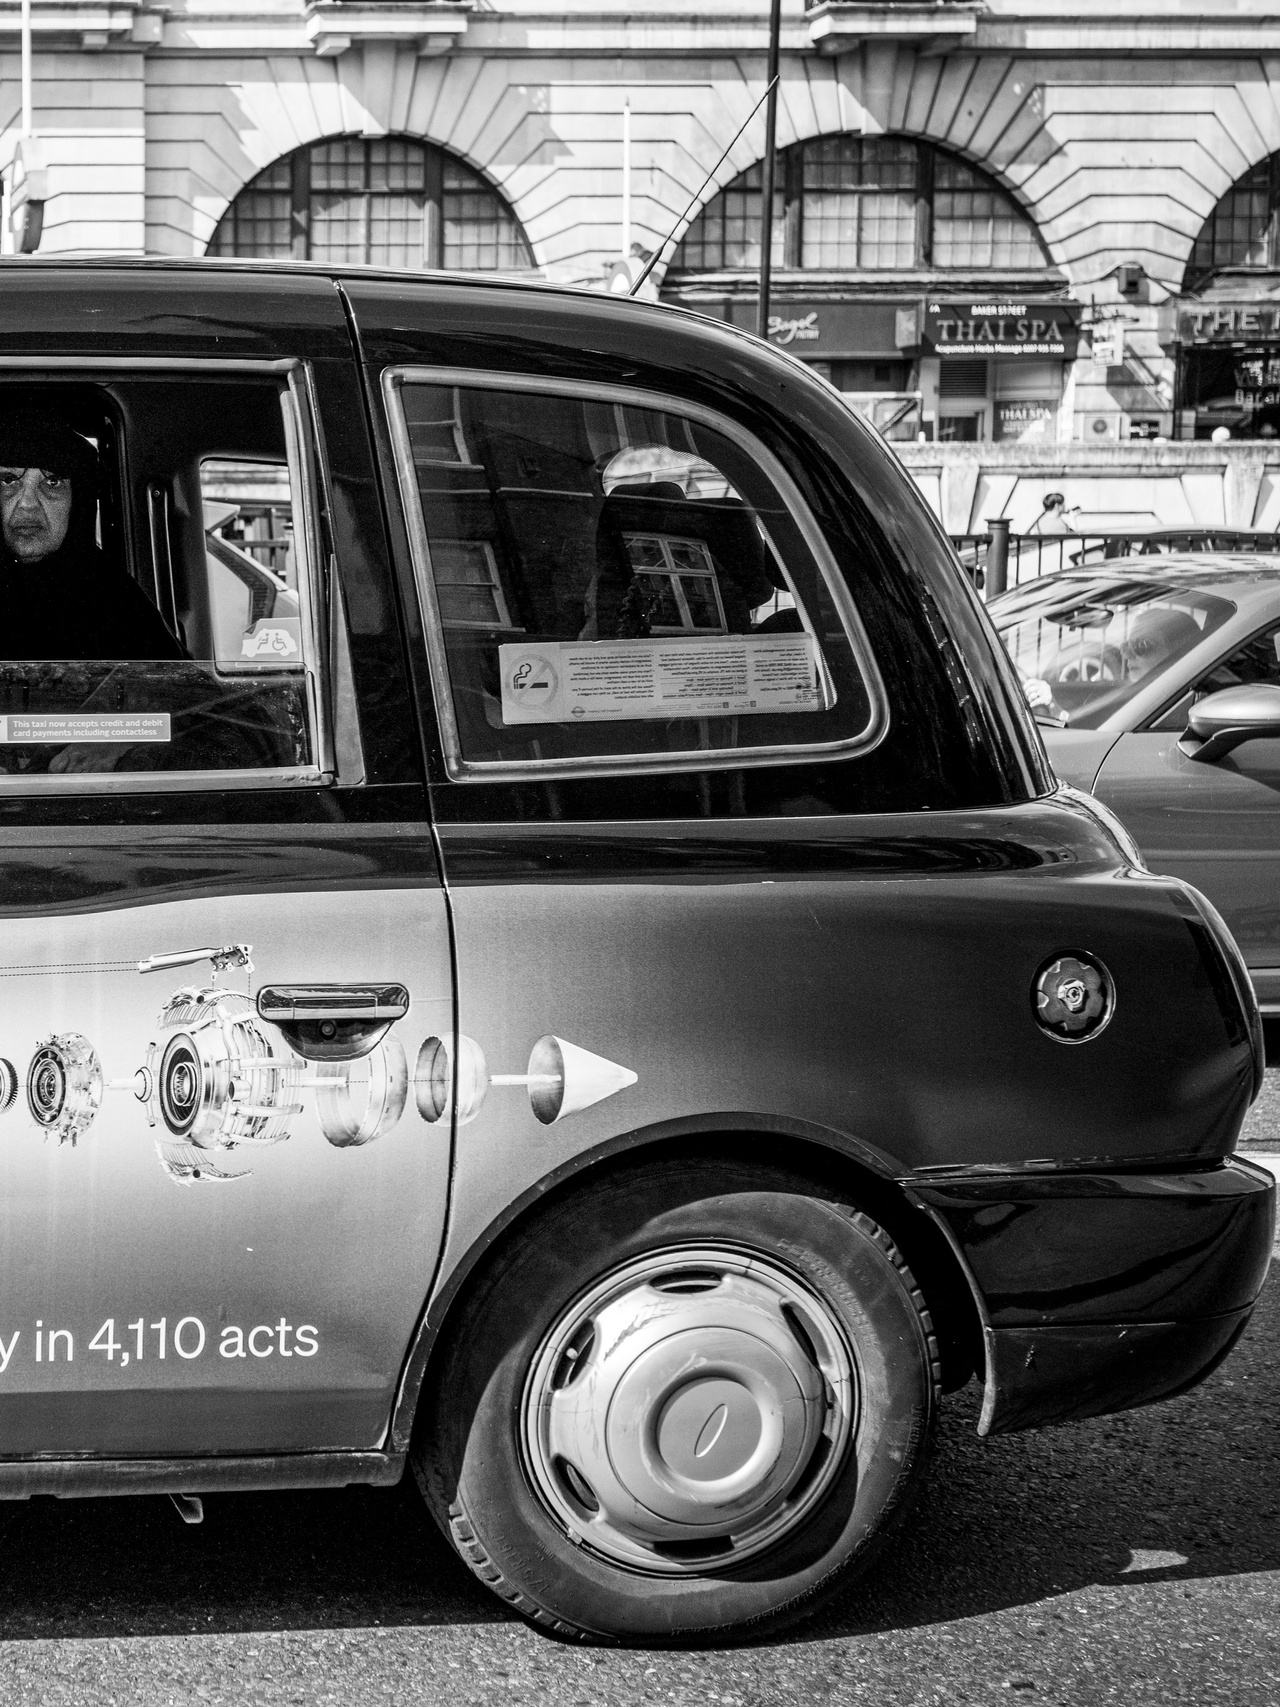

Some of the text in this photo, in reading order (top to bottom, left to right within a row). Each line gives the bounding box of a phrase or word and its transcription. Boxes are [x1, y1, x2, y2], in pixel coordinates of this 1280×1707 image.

[971, 305, 1027, 316] BAKER STREET
[1189, 307, 1260, 331] THE
[936, 319, 1063, 341] THAI SPA
[1000, 408, 1028, 420] THAI
[12, 720, 30, 728] This
[31, 720, 47, 728] taxi
[67, 720, 99, 729] accepts
[100, 719, 124, 727] credit
[125, 719, 141, 727] and
[142, 719, 164, 727] debit
[13, 728, 157, 738] card payments including contactless
[35, 1319, 74, 1362] in
[88, 1316, 206, 1367] 4,110
[218, 1317, 320, 1359] acts
